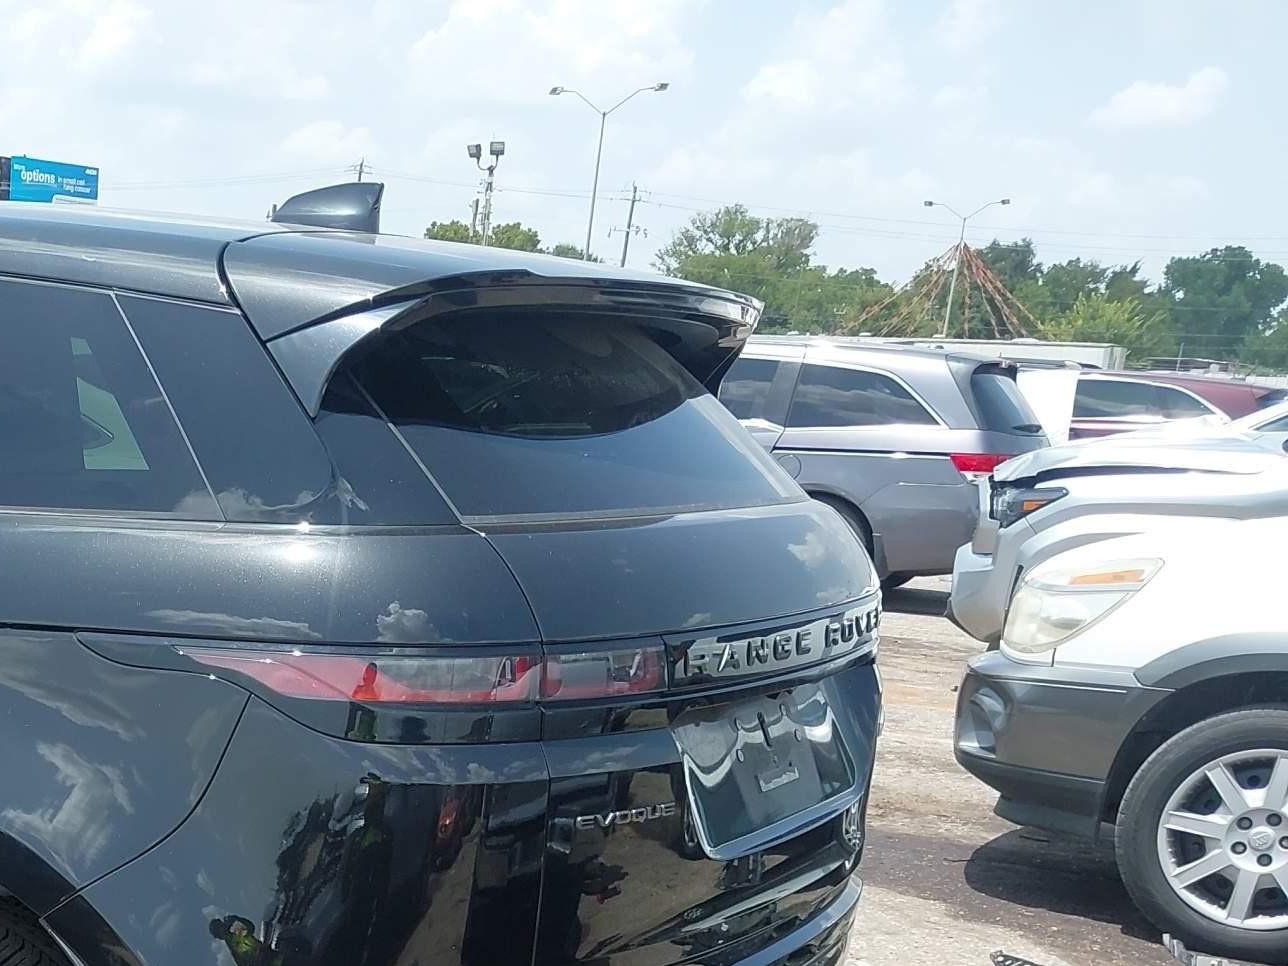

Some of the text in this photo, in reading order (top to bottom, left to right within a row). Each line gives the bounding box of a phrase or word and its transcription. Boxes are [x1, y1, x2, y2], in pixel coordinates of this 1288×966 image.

[20, 169, 56, 185] options
[683, 606, 881, 677] RANGE ROVE
[575, 802, 675, 830] EVOQUE
